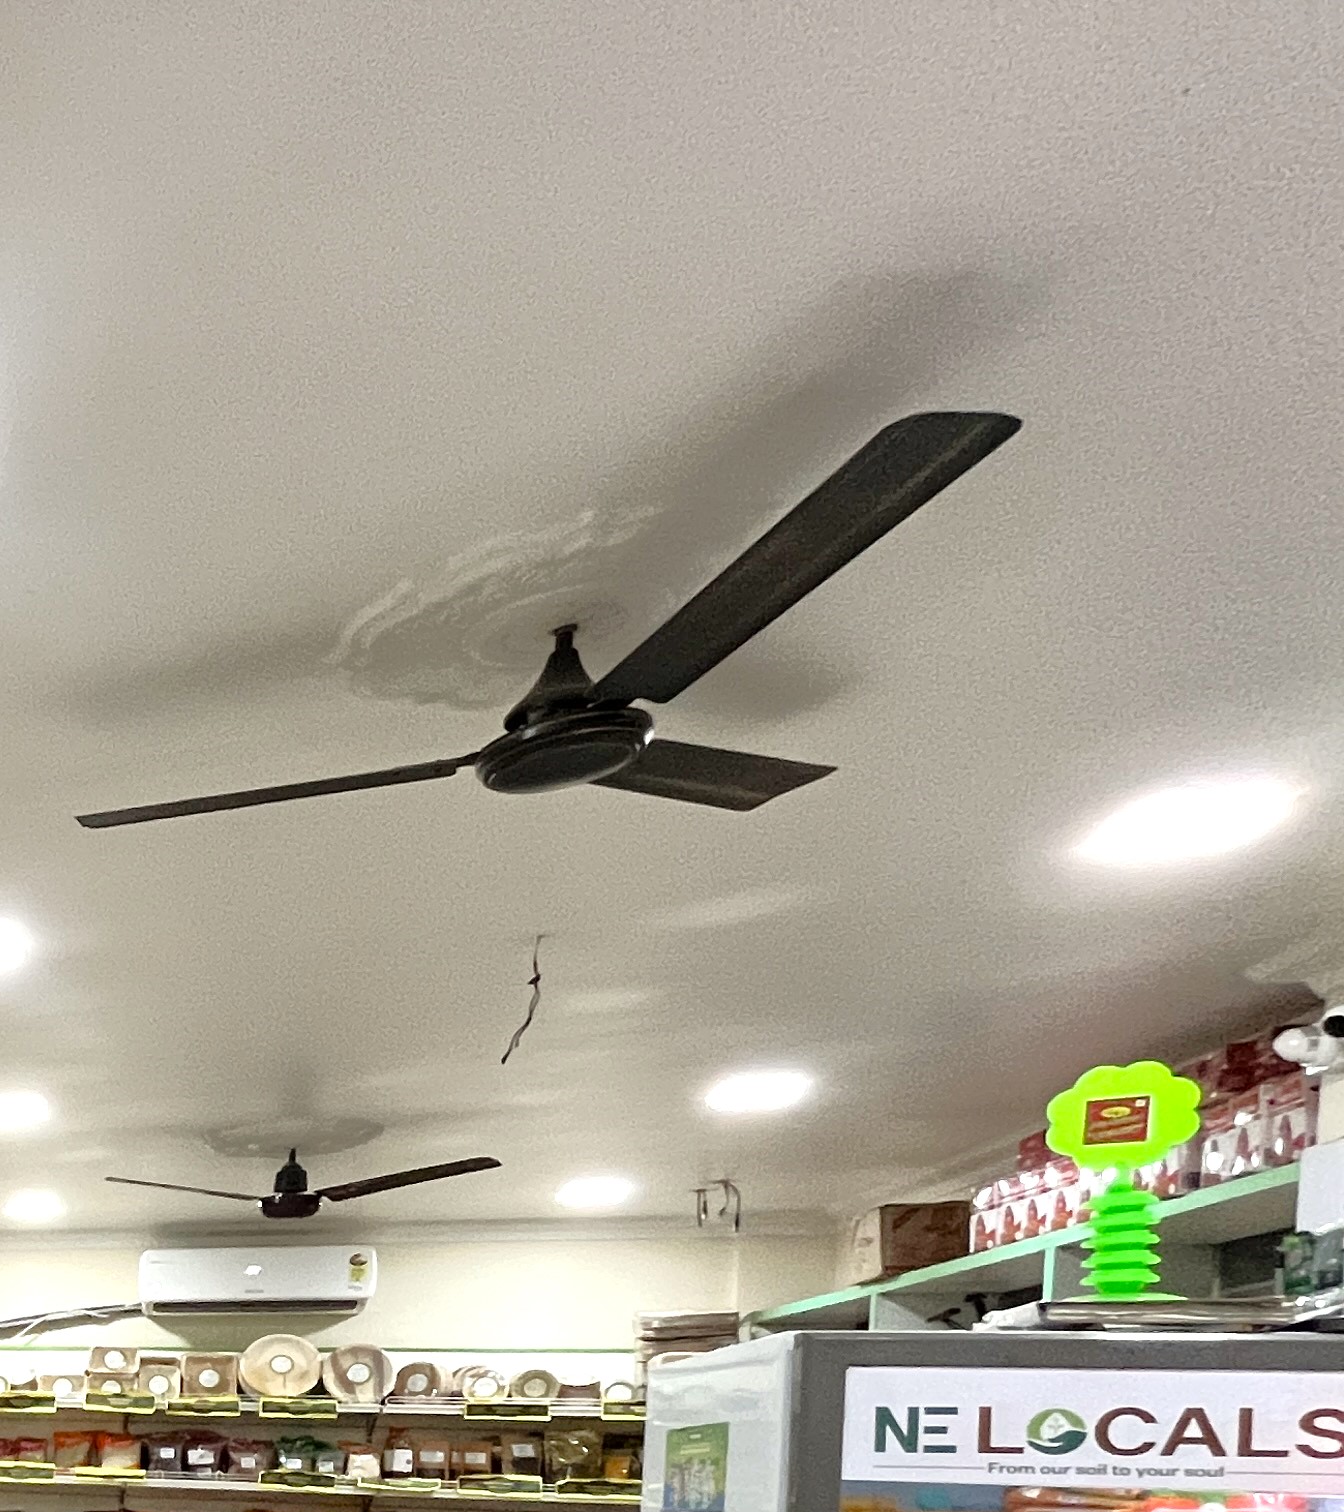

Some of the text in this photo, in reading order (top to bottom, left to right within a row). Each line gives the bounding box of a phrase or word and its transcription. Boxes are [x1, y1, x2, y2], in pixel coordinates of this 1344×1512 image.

[986, 1461, 1225, 1480] From our soil to your soul
